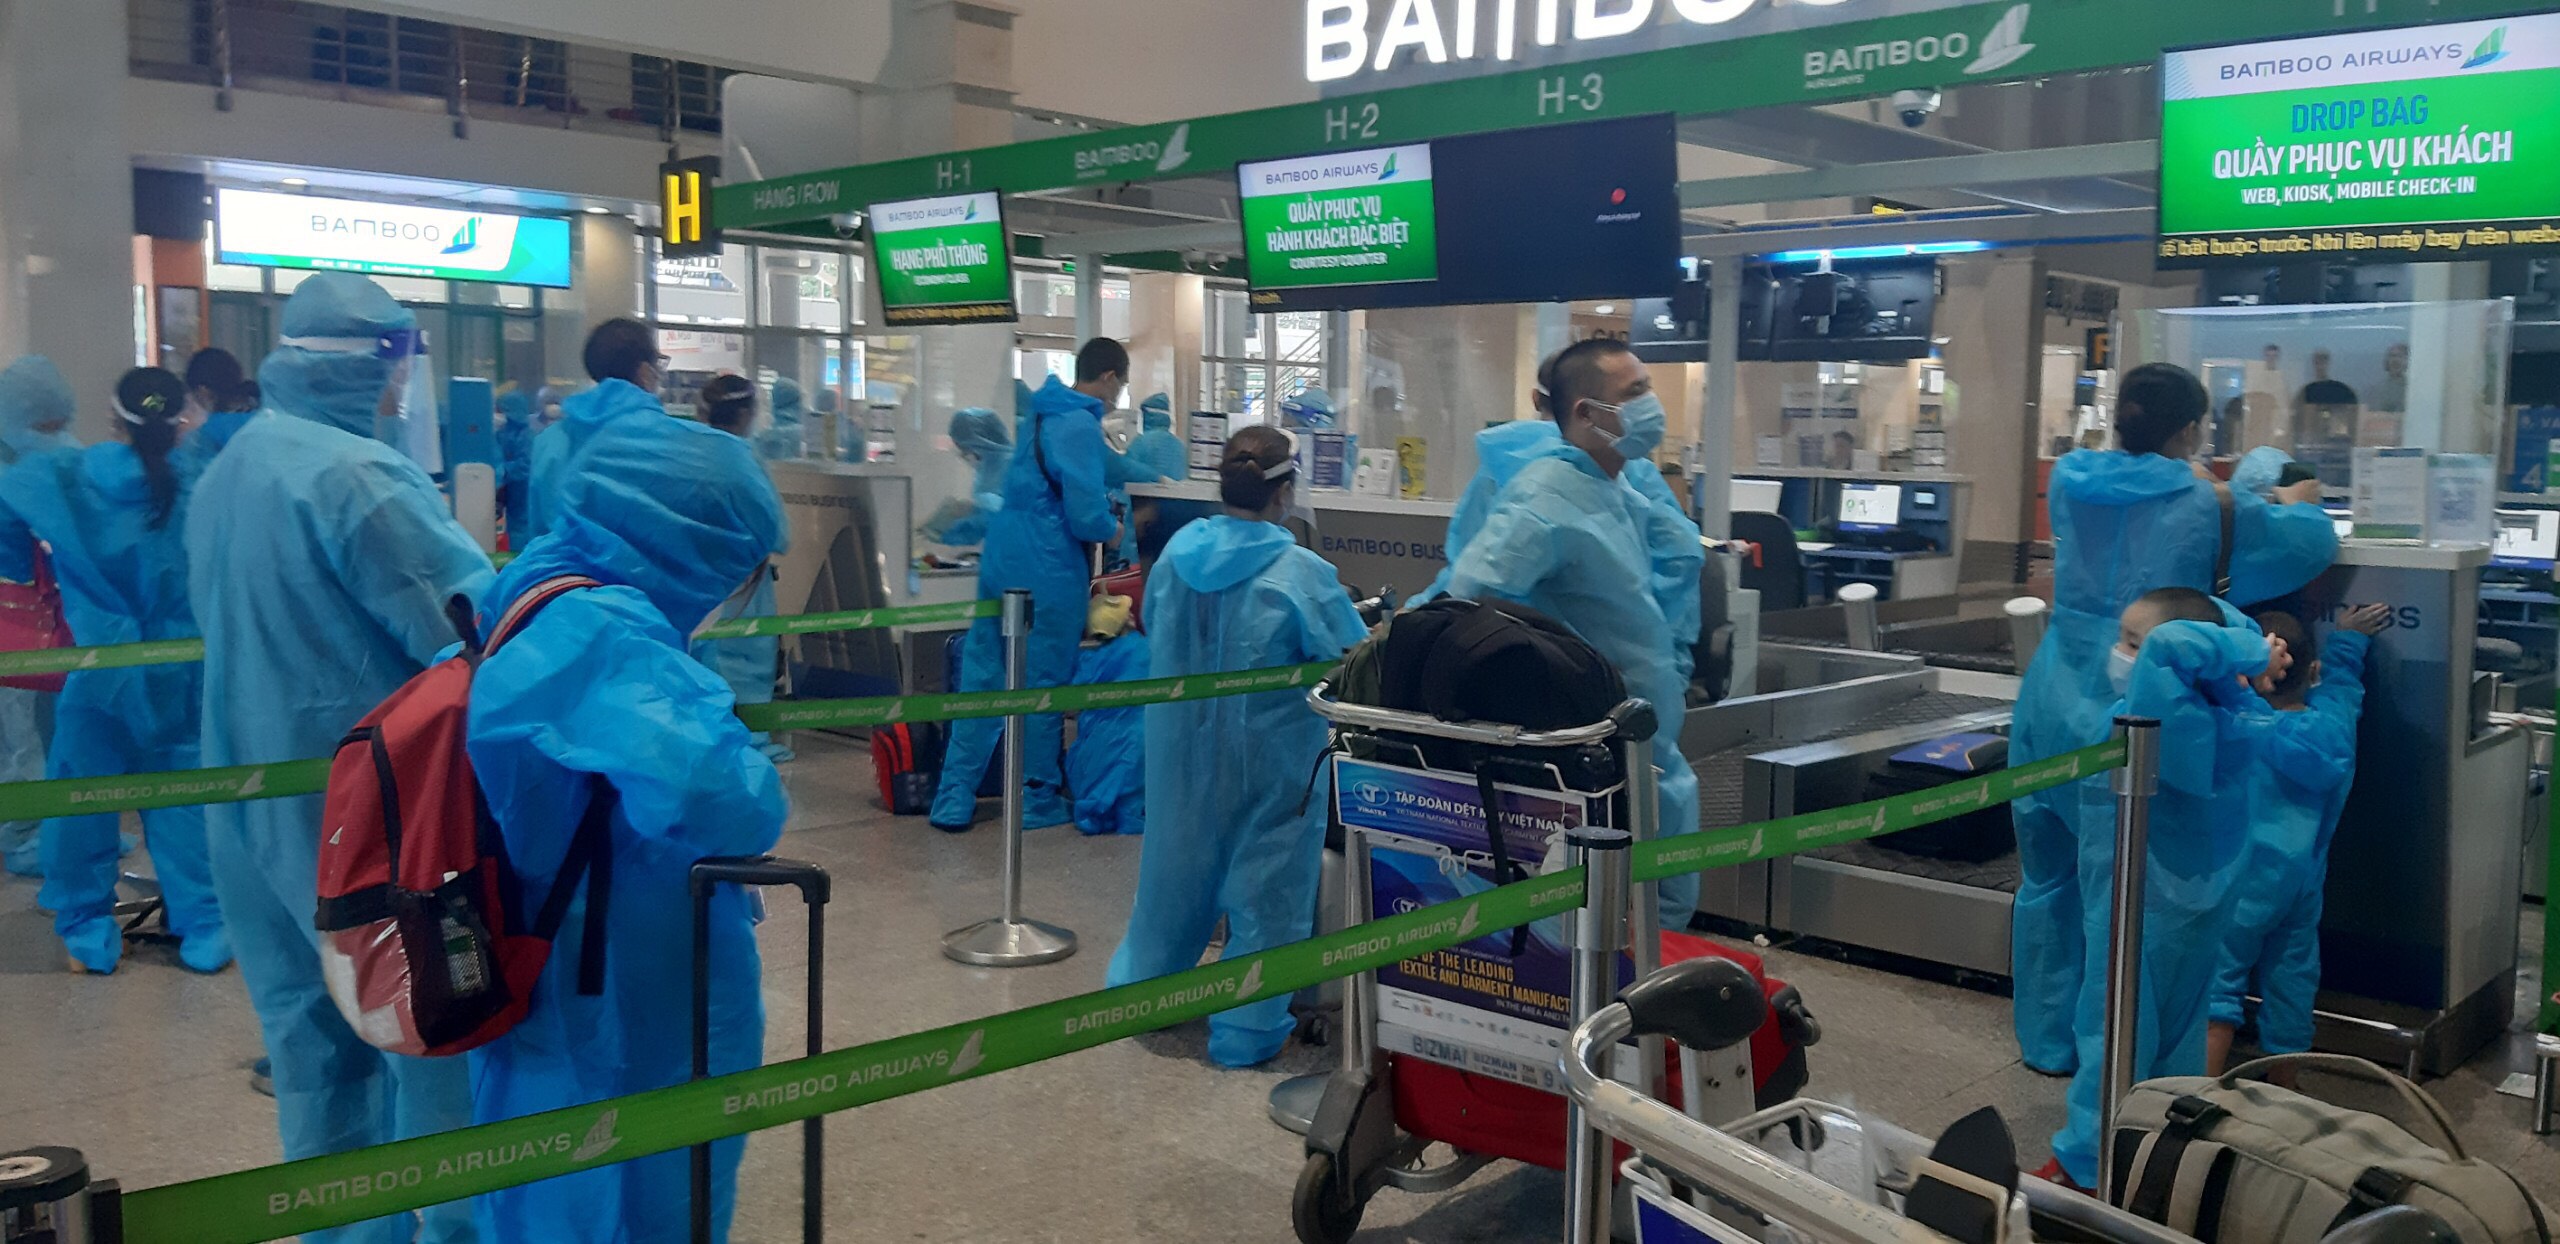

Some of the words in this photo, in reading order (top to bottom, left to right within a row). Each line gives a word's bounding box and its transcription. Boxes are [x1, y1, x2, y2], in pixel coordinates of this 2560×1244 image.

[1804, 32, 1970, 76] BAMBOO
[2220, 55, 2332, 80] BAMBOO
[2343, 43, 2462, 69] AIRWAYS
[1537, 73, 1604, 116] H-3
[1325, 103, 1379, 143] H-2
[2291, 99, 2365, 133] DROP
[2371, 94, 2428, 127] BAG
[1075, 141, 1159, 170] BAMBOO
[2213, 136, 2284, 179] QUẦY
[2288, 140, 2362, 179] PHỤC
[2367, 137, 2405, 176] VỤ
[2412, 125, 2513, 167] KHÁCH
[937, 158, 972, 189] H-1
[1266, 169, 1319, 185] BAMBOO
[1323, 163, 1379, 179] AIRWAYS
[804, 180, 840, 205] ROW
[2240, 187, 2282, 206] WEB,
[2284, 184, 2334, 205] KIOSK,
[2336, 180, 2396, 199] MOBILE
[2397, 175, 2476, 196] CHECK-IN
[667, 171, 701, 244] H
[1324, 197, 1360, 224] PHỤC
[1361, 195, 1382, 222] VỤ
[311, 215, 440, 242] BAMBOO
[1266, 226, 1303, 252] HÀNH
[1305, 222, 1350, 250] KHÁCH
[1350, 219, 1378, 251] ĐẶC
[1379, 216, 1410, 249] BIỆT
[2312, 232, 2344, 251] khi
[2425, 228, 2464, 250] bay
[890, 248, 922, 275] HẠNG
[948, 238, 988, 267] THÔNG
[1290, 255, 1340, 269] COURTESY
[1341, 252, 1388, 267] COUNTER
[1321, 535, 1406, 558] BAMBOO
[69, 786, 153, 804] BAMBOO
[159, 778, 238, 796] AIRWAYS
[1394, 790, 1416, 806] TẬP
[1417, 796, 1452, 813] ĐOÀN
[1454, 803, 1477, 818] DỆT
[1480, 808, 1505, 823] MY
[1507, 812, 1534, 829] VIỆT
[1657, 846, 1701, 866] BAMBOO
[1705, 838, 1749, 857] AIRWAYS
[1530, 880, 1584, 907] BAMBOO
[1322, 935, 1392, 967] BAMBOO
[1396, 916, 1458, 947] AIRWAYS
[1439, 951, 1460, 970] THE
[1464, 958, 1514, 982] LEADING
[1439, 970, 1460, 986] AND
[1461, 974, 1510, 998] GARMENT
[1065, 999, 1151, 1035] BAMBOO
[1156, 977, 1236, 1011] AIRWAYS
[723, 1073, 838, 1115] BAMBOO
[847, 1048, 950, 1087] AIRWAYS
[268, 1165, 423, 1215] BAMBOO
[436, 1132, 572, 1179] AIRWAYS
